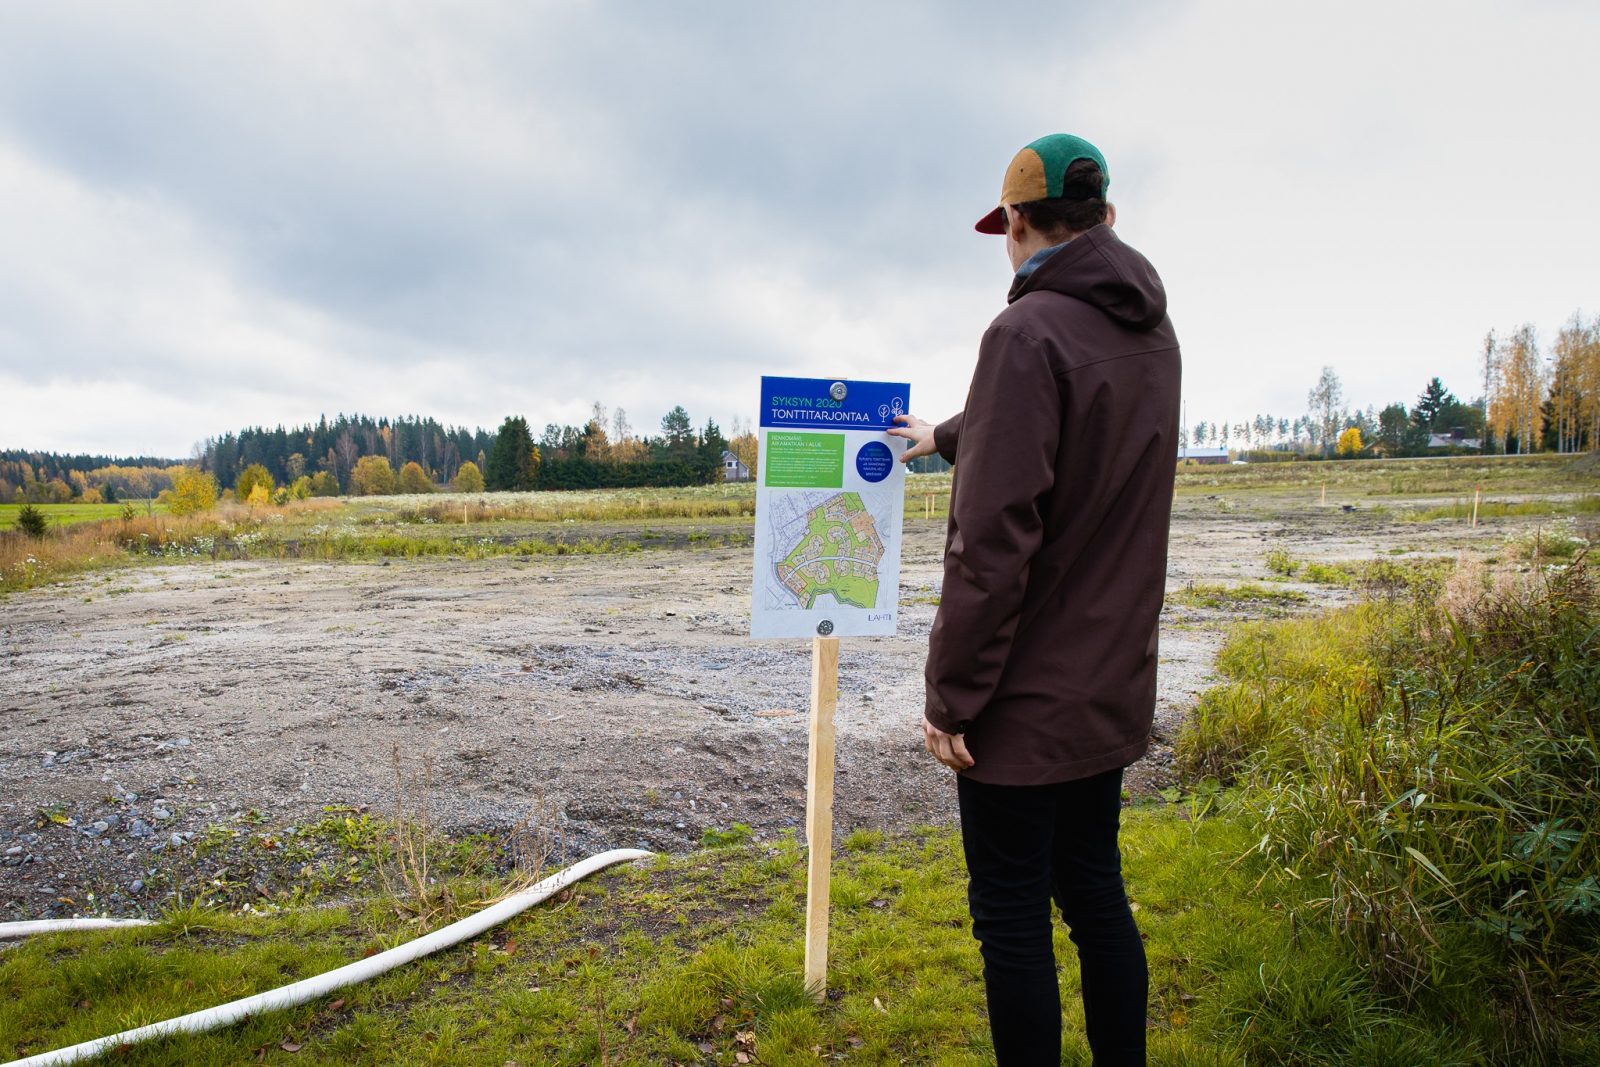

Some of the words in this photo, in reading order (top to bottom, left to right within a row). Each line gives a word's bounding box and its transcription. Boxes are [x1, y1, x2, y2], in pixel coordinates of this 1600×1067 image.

[772, 396, 812, 407] SYKSYN
[816, 398, 842, 408] 2020
[771, 409, 870, 421] TONTTITARJONTAA
